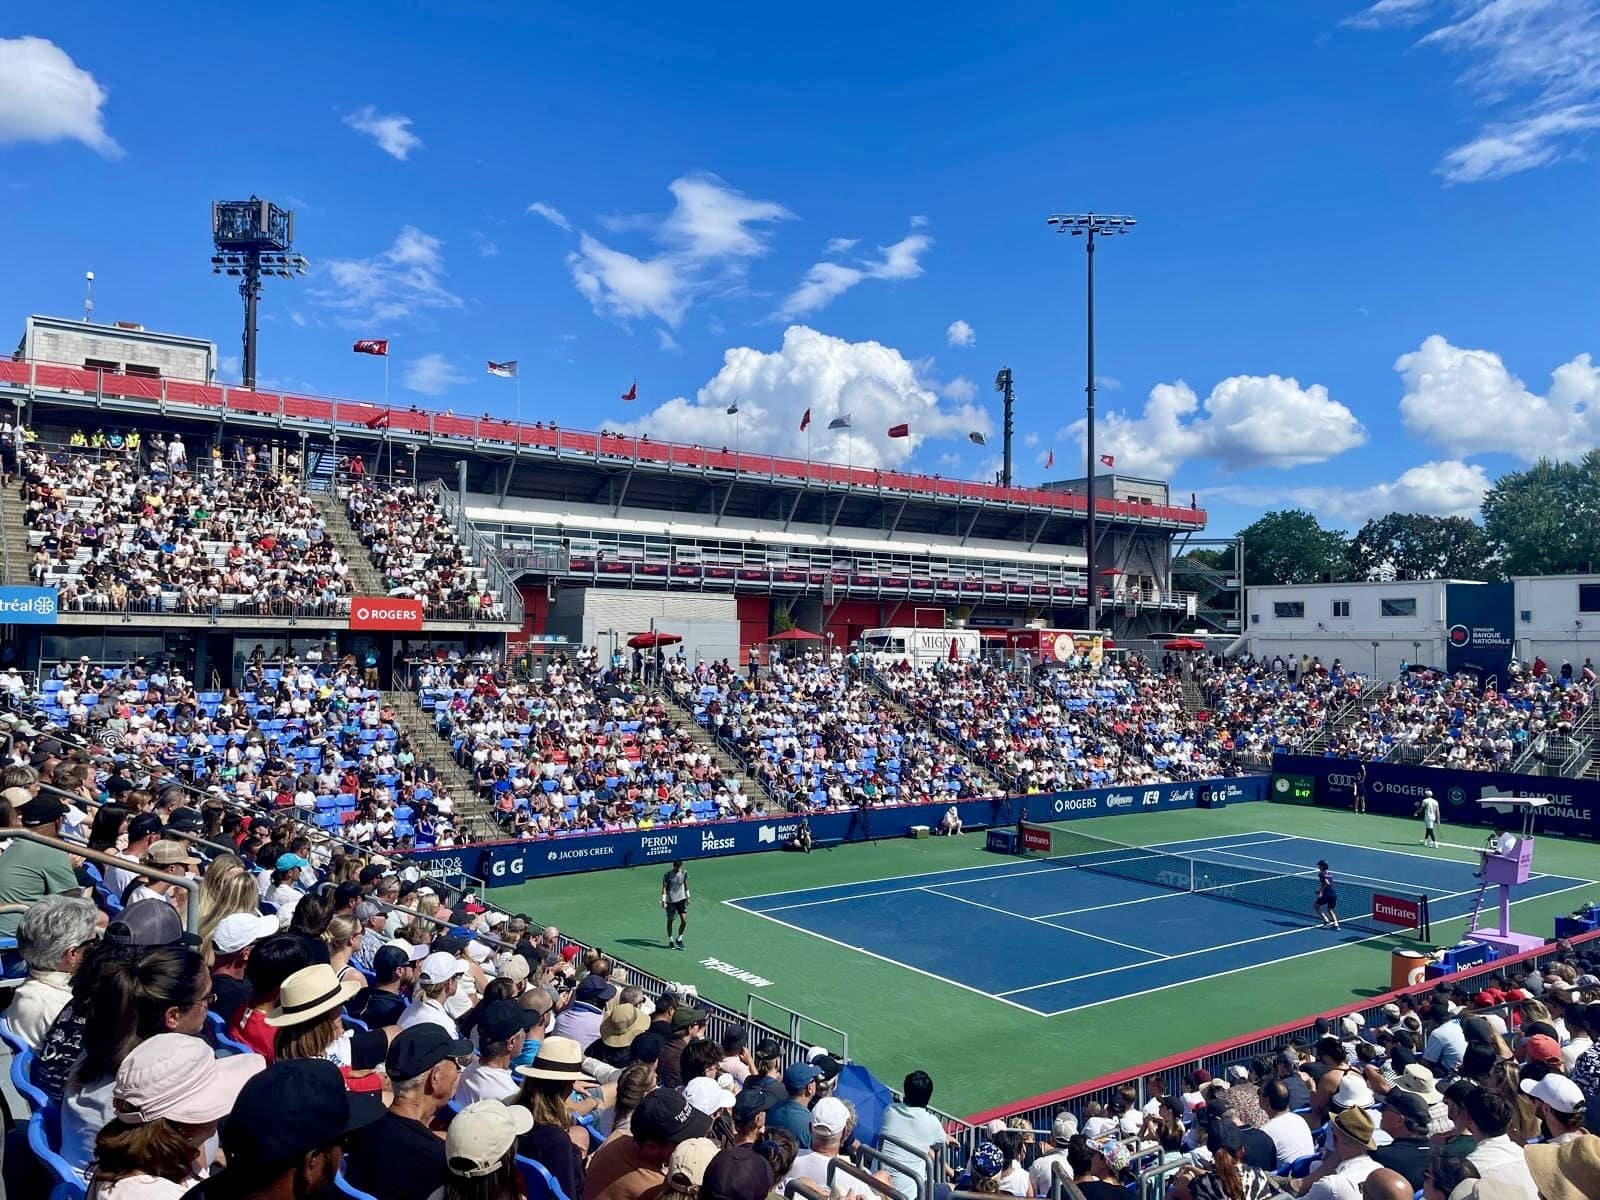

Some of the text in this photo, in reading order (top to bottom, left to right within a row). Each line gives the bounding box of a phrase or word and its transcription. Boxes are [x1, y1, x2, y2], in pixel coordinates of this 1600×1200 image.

[371, 609, 417, 620] ROGERS
[921, 635, 967, 649] MIGNN
[1064, 797, 1097, 811] ROGERS
[1519, 804, 1592, 820] NATIONALE
[641, 835, 678, 848] PERONI
[701, 830, 715, 841] LA
[701, 838, 736, 851] PRESSE
[590, 846, 614, 857] CREEK
[492, 860, 506, 876] G
[510, 857, 524, 874] G
[1375, 903, 1417, 920] Emirates
